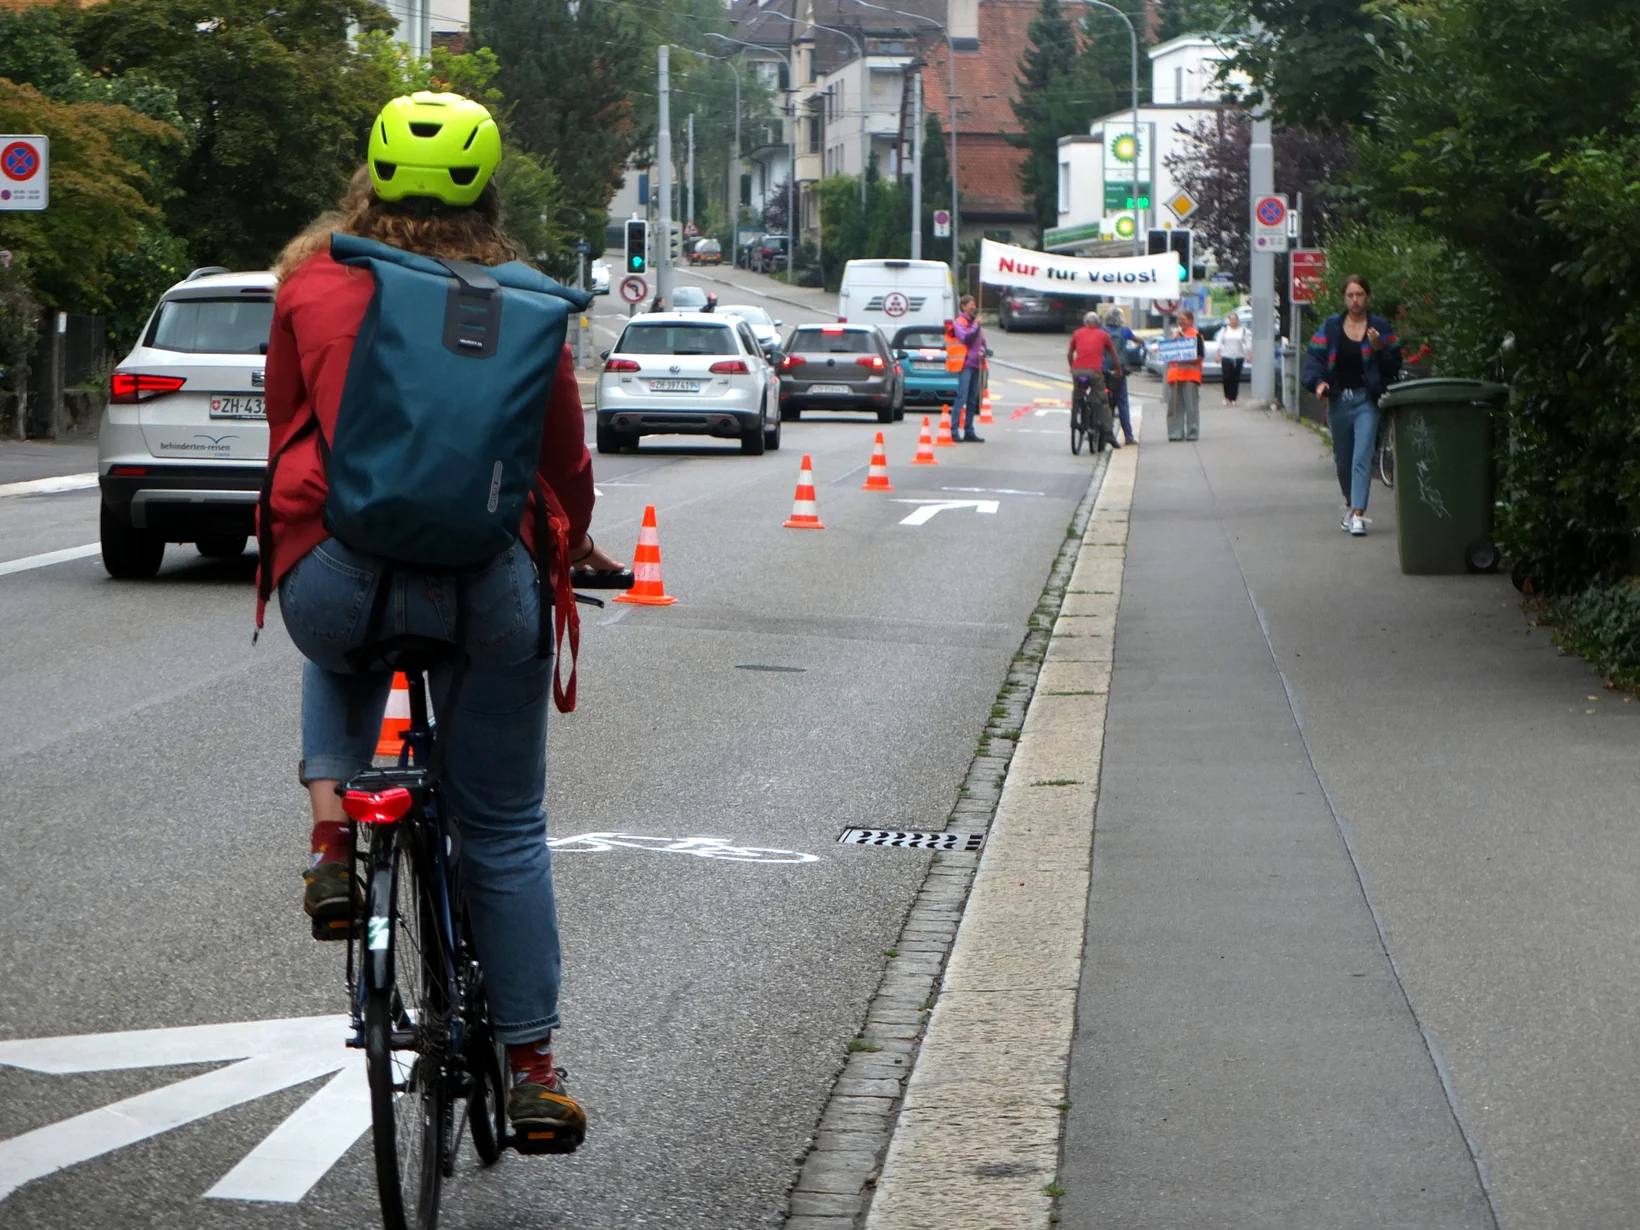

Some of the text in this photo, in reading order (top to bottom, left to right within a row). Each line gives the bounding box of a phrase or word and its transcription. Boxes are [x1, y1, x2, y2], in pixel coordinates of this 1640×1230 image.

[998, 257, 1039, 277] Nur
[1088, 268, 1157, 284] Velos!
[160, 442, 231, 451] behinderten-reisen
